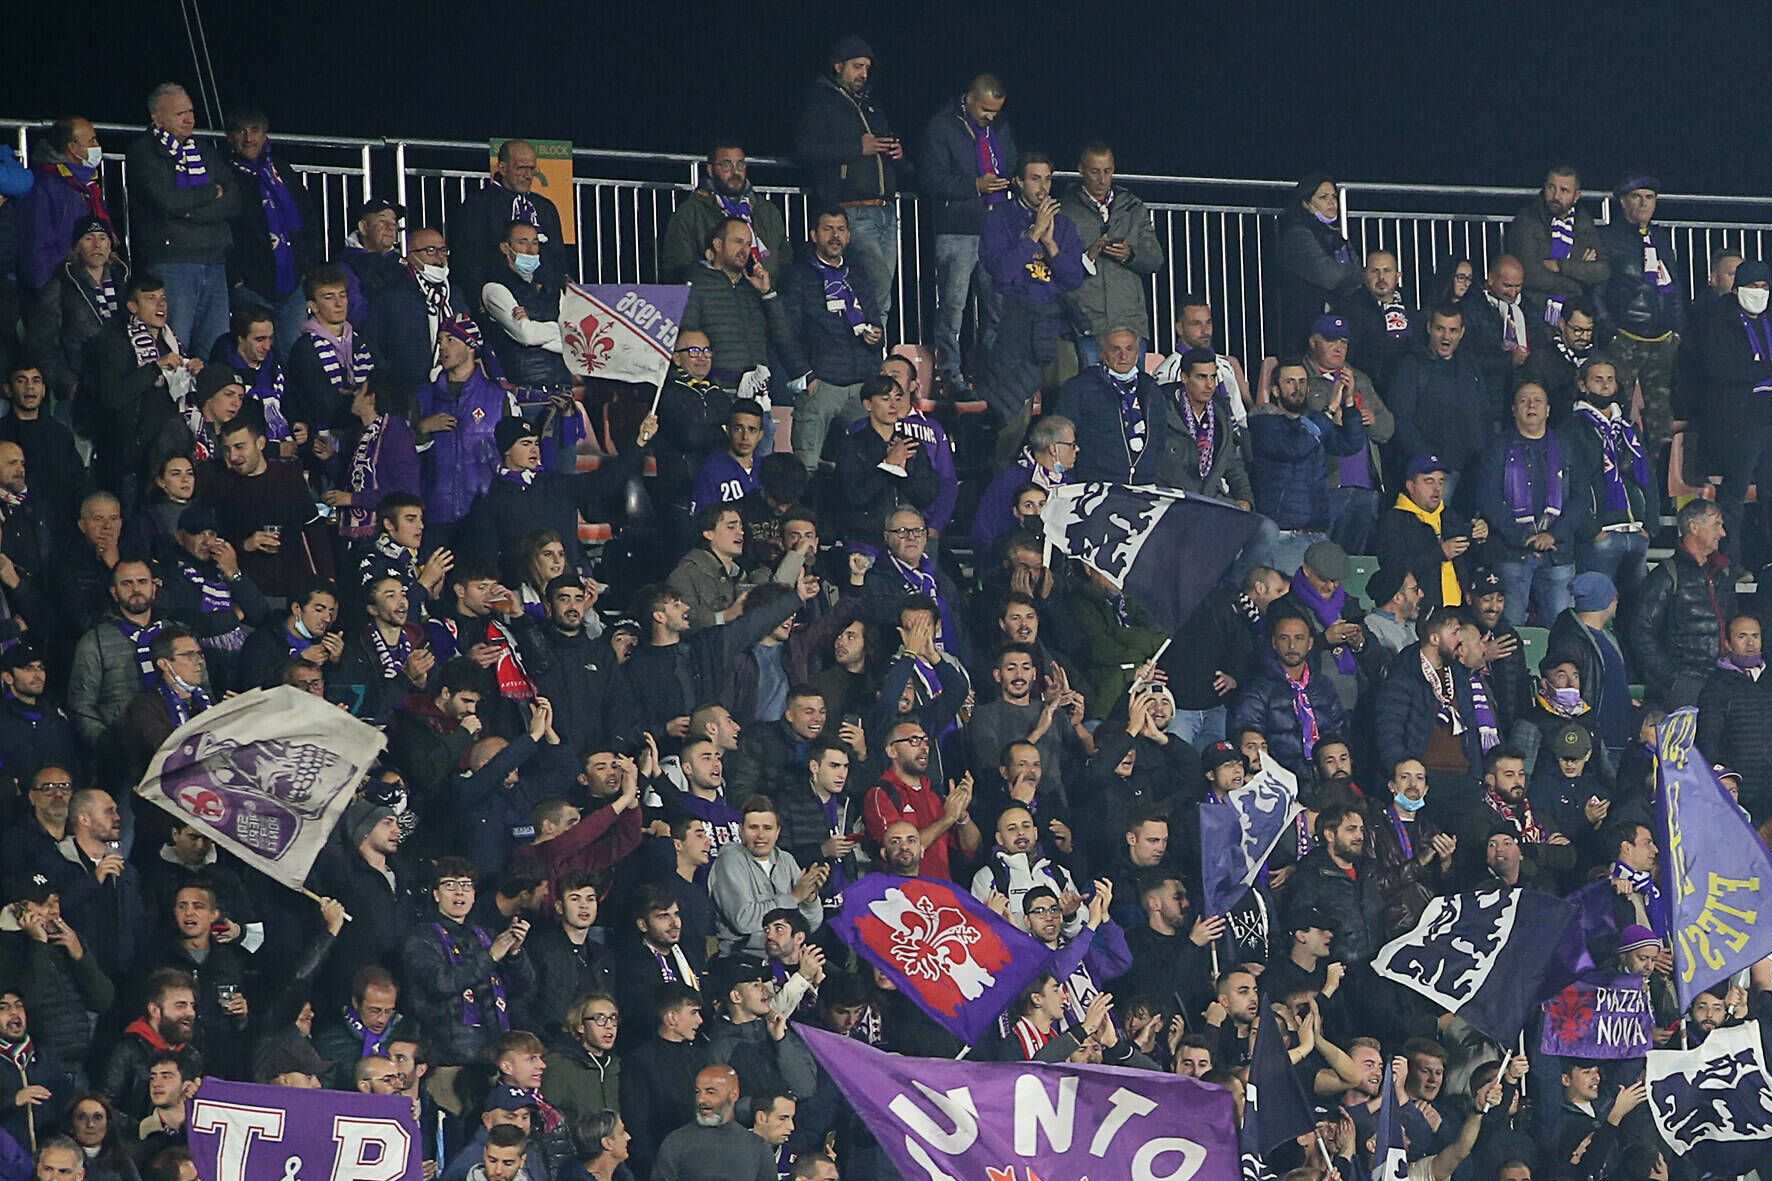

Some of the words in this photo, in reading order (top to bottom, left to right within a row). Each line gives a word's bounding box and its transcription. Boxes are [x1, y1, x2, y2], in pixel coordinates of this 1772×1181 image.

[893, 420, 938, 445] ENTINA
[720, 479, 745, 502] 20
[1596, 1014, 1648, 1047] NOVA
